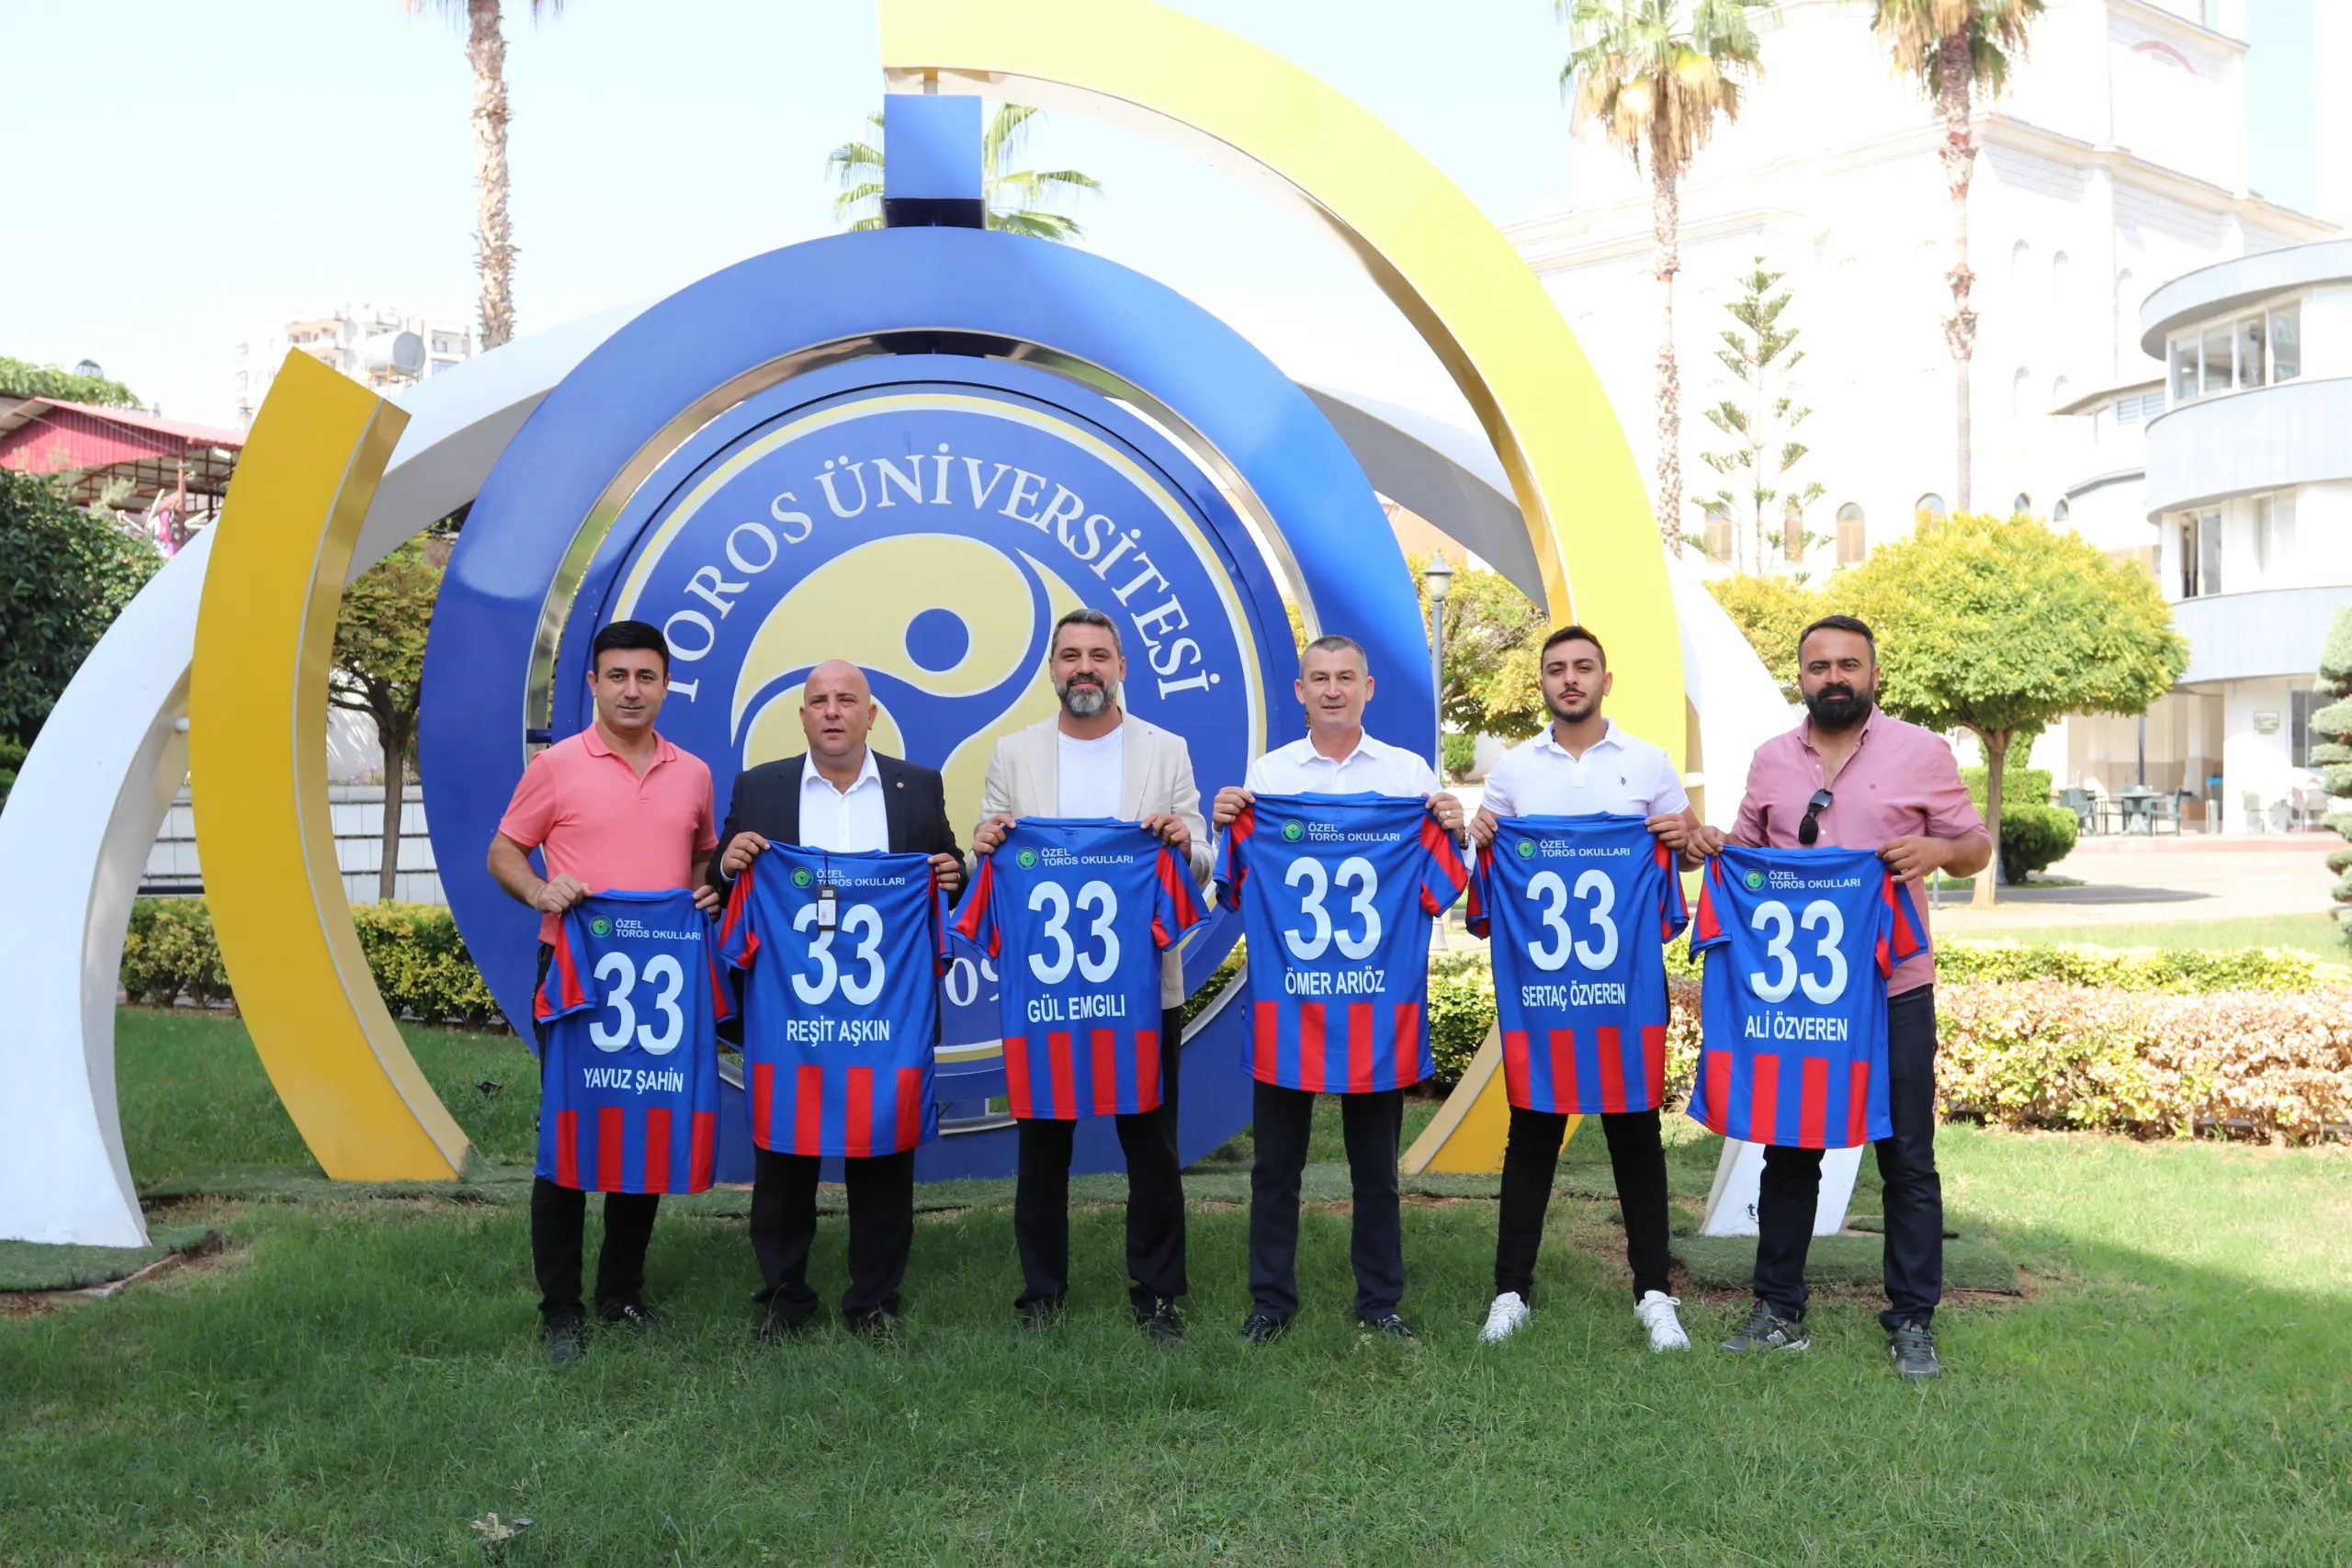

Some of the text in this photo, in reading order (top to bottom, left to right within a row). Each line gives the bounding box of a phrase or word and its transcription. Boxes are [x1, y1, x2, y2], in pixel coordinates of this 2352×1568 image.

[813, 442, 1221, 701] ÜNİVERSİTESİ
[1307, 822, 1338, 832] ÖZEL
[1308, 832, 1400, 841] TOROS OKULLARI
[1041, 847, 1070, 858] ÖZEL
[1540, 839, 1568, 849] ÖZEL
[1541, 848, 1576, 858] TOROS
[1578, 847, 1630, 857] OKULLARI
[816, 868, 845, 879] ÖZEL
[1043, 856, 1078, 866] TOROS
[1080, 855, 1133, 864] OKULLARI
[1769, 869, 1798, 880] ÖZEL
[854, 876, 906, 887] OKULLARI
[1770, 878, 1860, 889] TOROS OKULLARI
[1283, 856, 1382, 961] 33
[1526, 869, 1619, 971] 33
[616, 918, 643, 930] ÖZEL
[616, 929, 701, 941] TOROS OKULLARI
[1027, 880, 1120, 985] 33
[791, 903, 886, 1006] 33
[1750, 899, 1849, 1005] 33
[1284, 965, 1385, 996] ÖMER ARIÖZ
[589, 951, 684, 1055] 33
[1027, 994, 1065, 1022] GÜL
[1521, 980, 1626, 1012] SERTAÇ ÖZVEREN
[786, 1015, 890, 1047] REŞİT AŞKIN
[1745, 1010, 1848, 1042] ALİ ÖZVEREN
[583, 1066, 684, 1094] YAVUZ ŞAHİN
